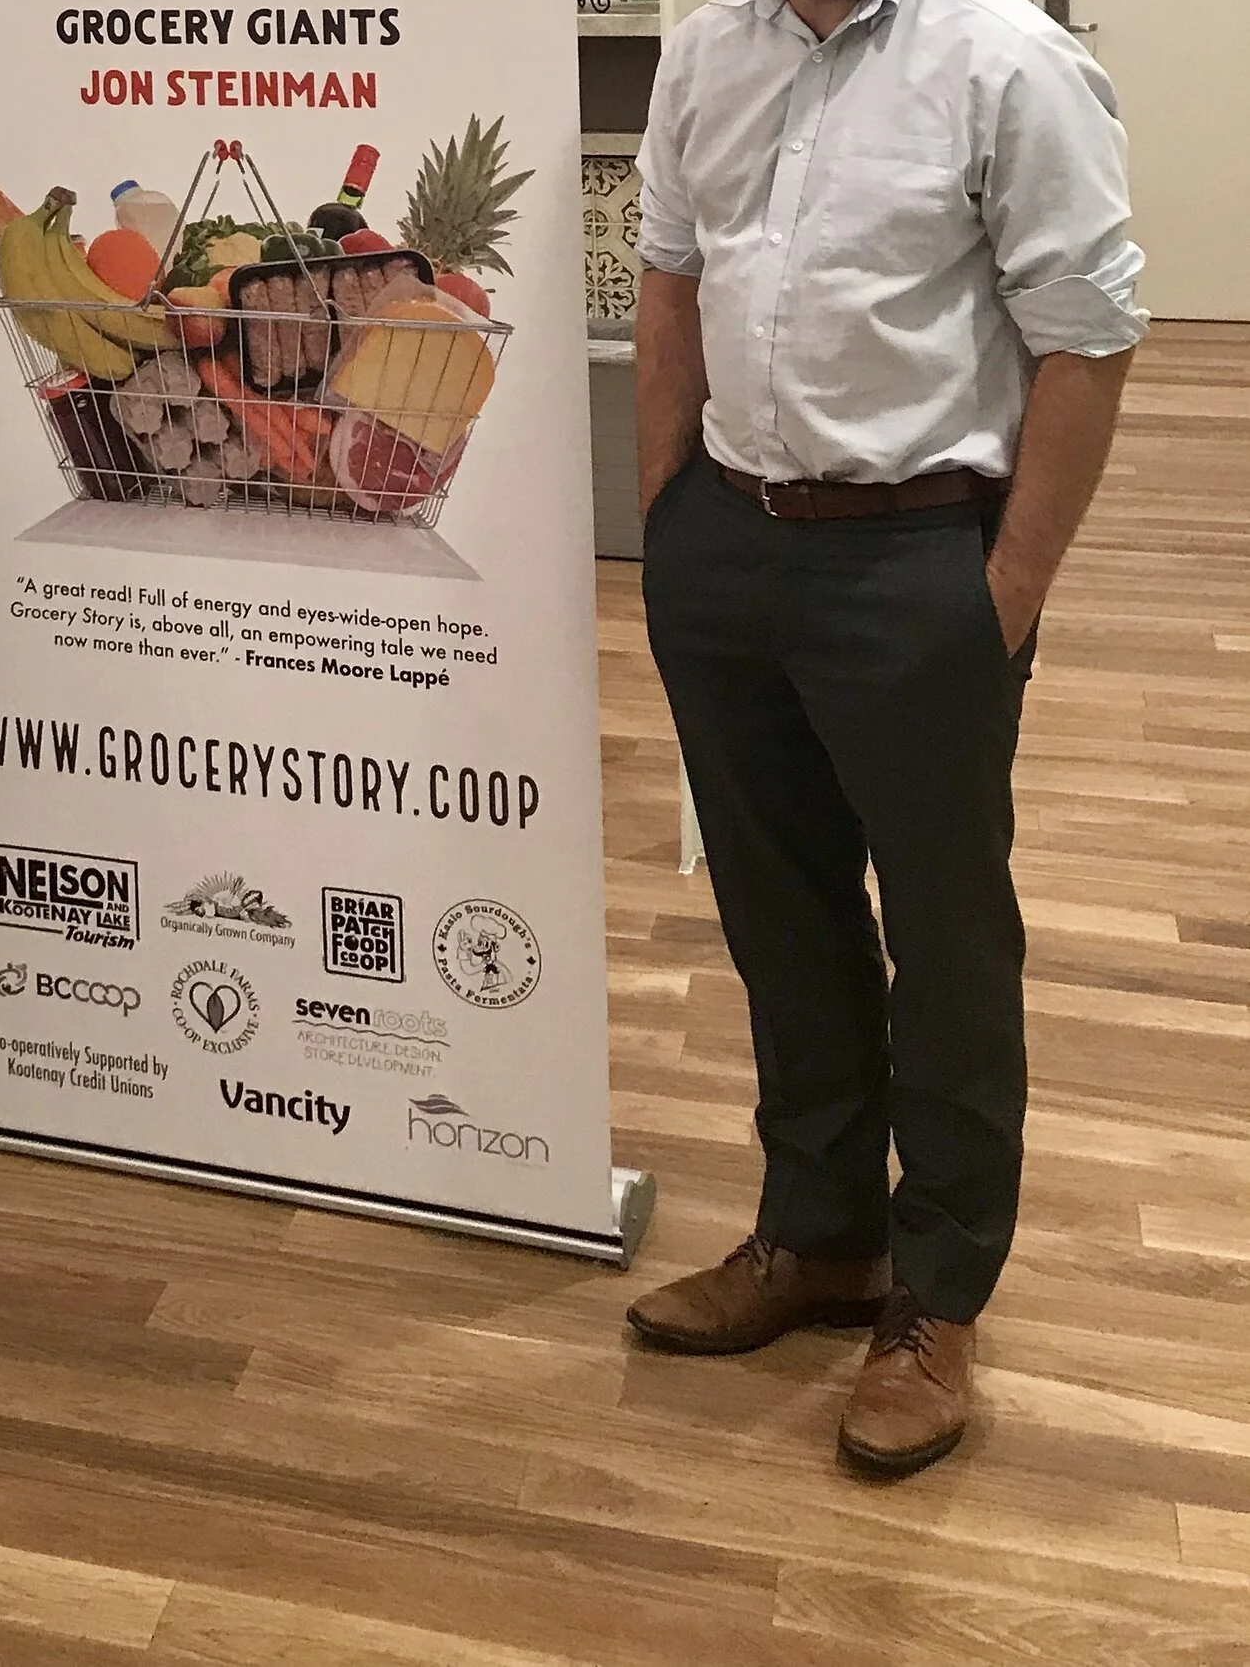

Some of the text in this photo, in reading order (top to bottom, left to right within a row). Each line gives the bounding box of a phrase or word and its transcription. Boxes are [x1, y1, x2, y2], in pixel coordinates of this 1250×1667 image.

[56, 8, 401, 46] GROCERY GIANTS
[81, 70, 377, 109] JON STEINMAN
[43, 583, 85, 599] great
[91, 585, 132, 603] read!
[139, 588, 166, 607] Full
[172, 591, 188, 608] of
[194, 598, 252, 618] energy
[259, 600, 291, 617] and
[298, 607, 430, 634] eyes-wide-open
[438, 615, 489, 639] hope.
[11, 602, 498, 664] Grocery Story is, above all, an empowering tale we need
[54, 634, 87, 647] now
[93, 638, 132, 653] more
[139, 638, 174, 658] than
[246, 650, 315, 672] Frances
[321, 658, 383, 679] Moore
[390, 665, 450, 689] Lappé
[97, 912, 131, 931] LAKE
[106, 902, 129, 913] AND
[331, 914, 395, 938] PATCH
[65, 925, 135, 950] Tourism
[160, 916, 296, 949] Organically Grown Company
[332, 934, 389, 954] FOOD
[171, 959, 227, 1001] ROCHDALE
[438, 957, 462, 991] Pasta
[296, 997, 448, 1037] seven roots
[7, 1057, 154, 1099] Kootenay Credit Unions
[84, 1046, 148, 1073] Supported
[153, 1055, 169, 1080] by
[220, 1078, 351, 1135] Vancity
[408, 1108, 550, 1163] horizon
